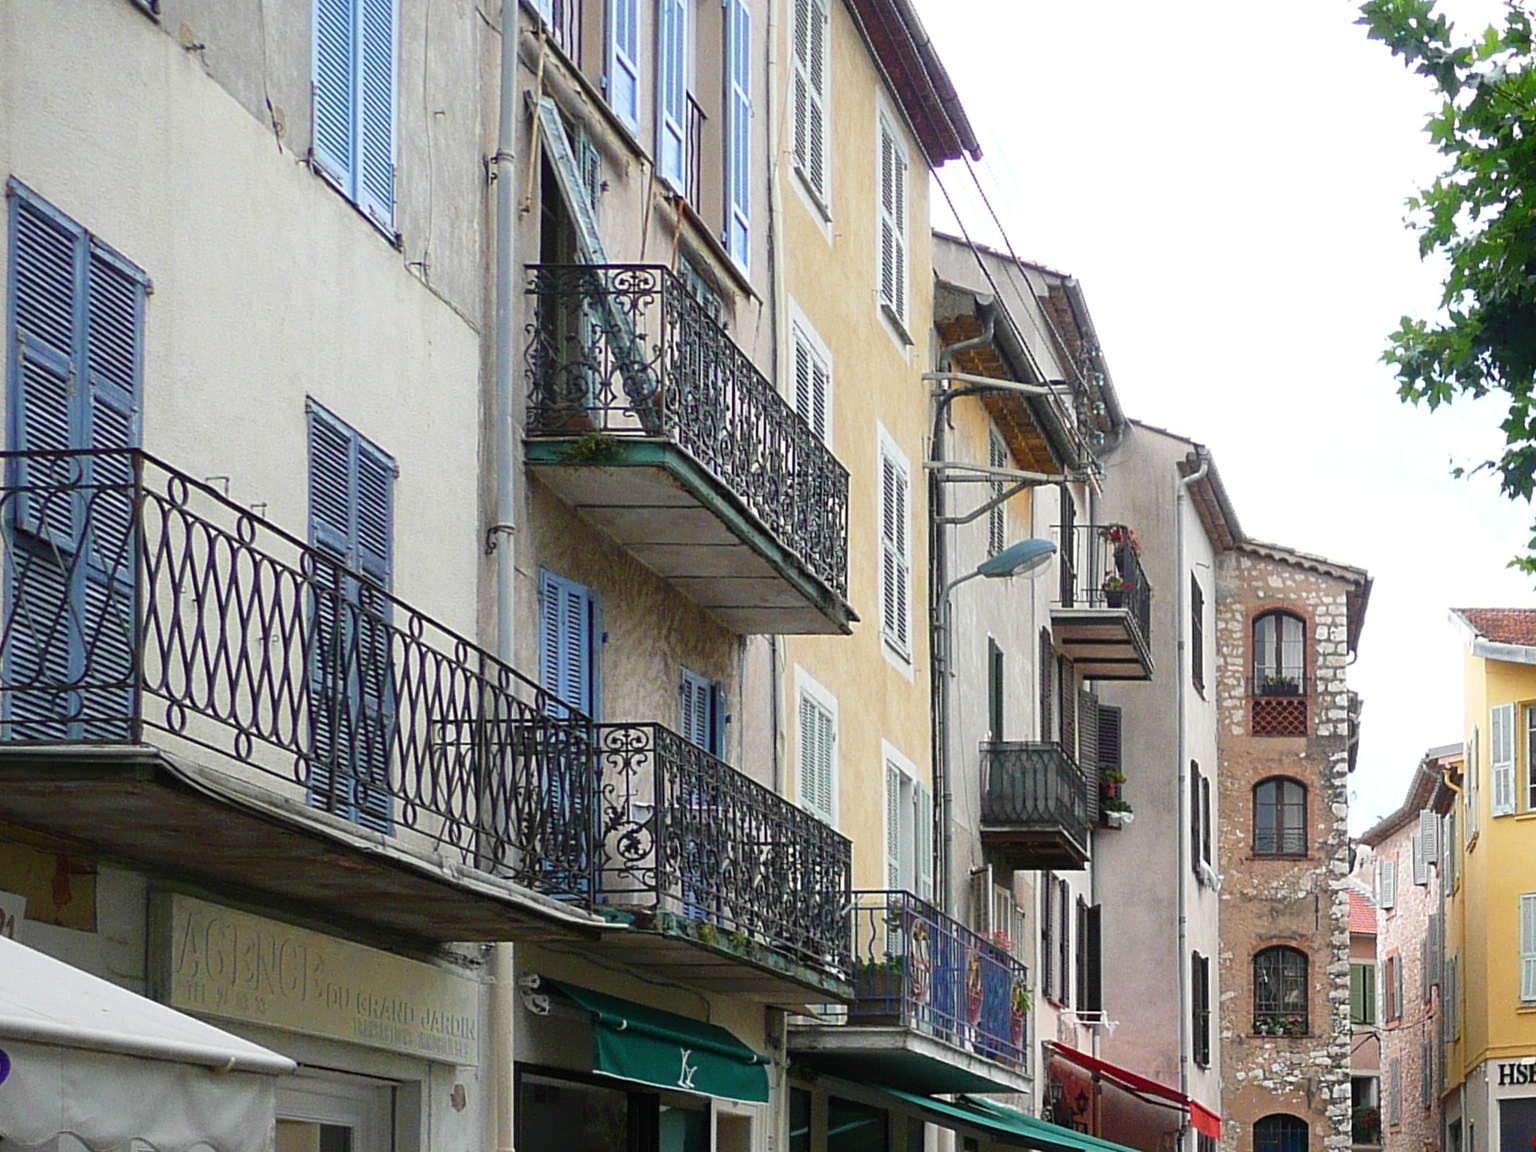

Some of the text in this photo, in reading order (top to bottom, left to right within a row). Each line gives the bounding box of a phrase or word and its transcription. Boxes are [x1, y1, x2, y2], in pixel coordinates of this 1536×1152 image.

[176, 911, 323, 1001] AGENCE
[326, 982, 476, 1041] DU GRAND JARDIN
